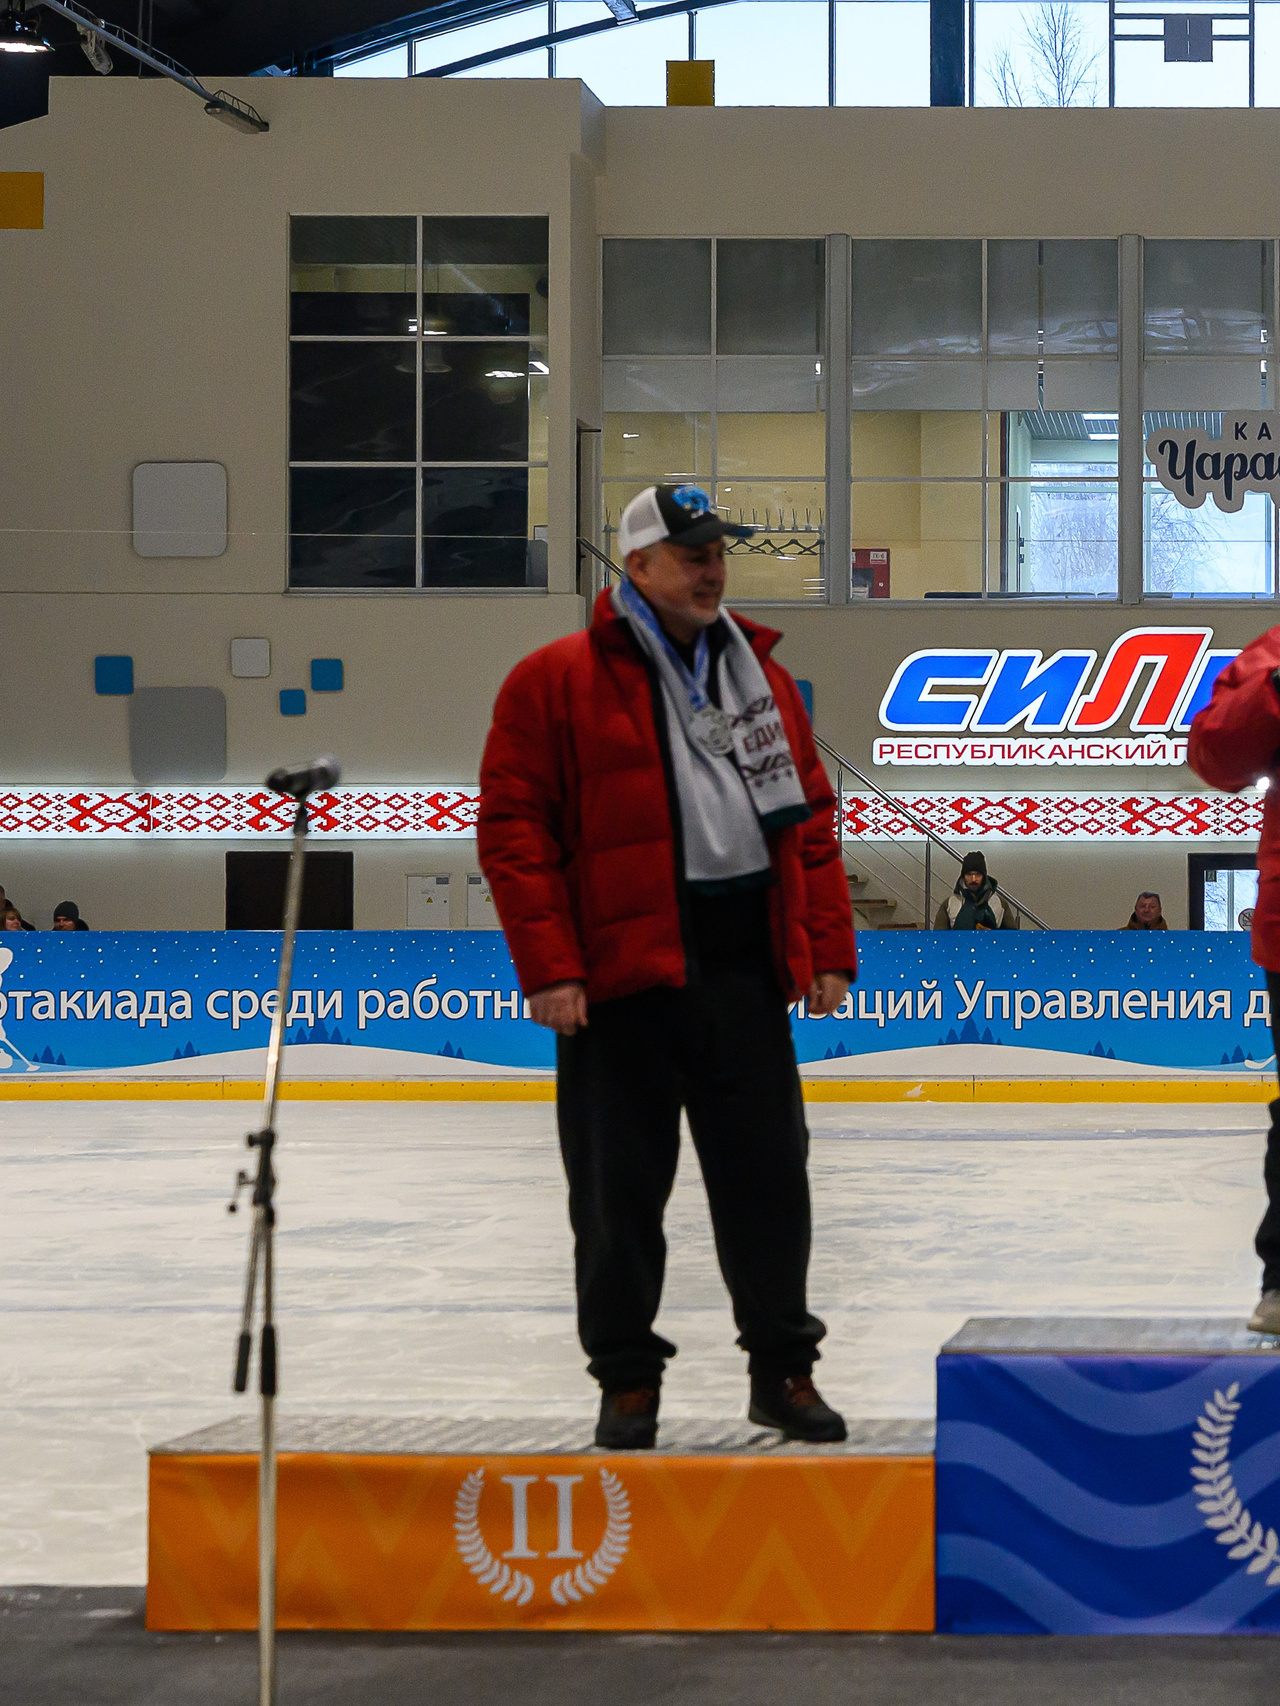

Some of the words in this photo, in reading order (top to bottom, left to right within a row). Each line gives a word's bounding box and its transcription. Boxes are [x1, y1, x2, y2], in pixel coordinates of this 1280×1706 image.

[878, 740, 1166, 760] РЕСПУБЛИКАНСКИЙ
[0, 989, 193, 1028] такиада
[206, 989, 343, 1030] среди
[787, 980, 943, 1028] аций
[954, 980, 1231, 1030] Управления
[501, 1474, 584, 1560] II
